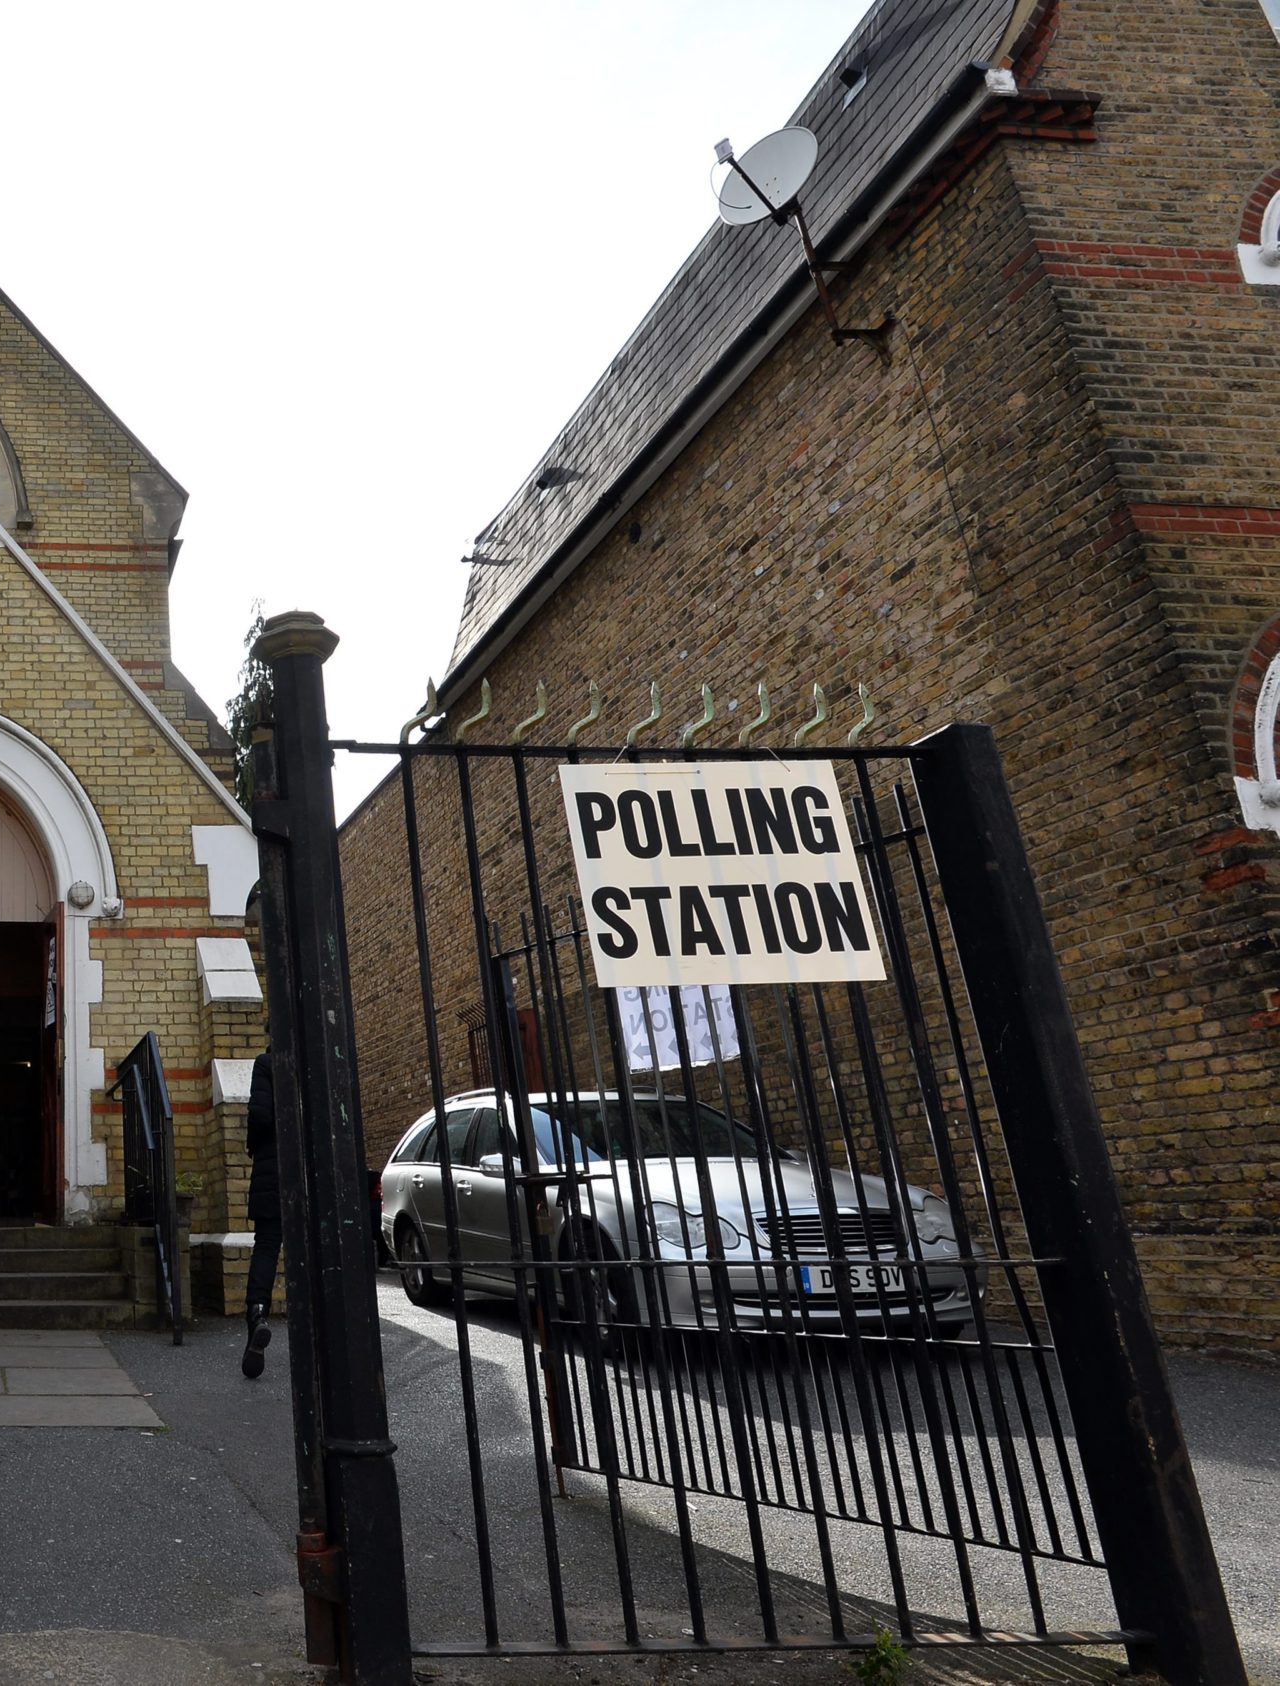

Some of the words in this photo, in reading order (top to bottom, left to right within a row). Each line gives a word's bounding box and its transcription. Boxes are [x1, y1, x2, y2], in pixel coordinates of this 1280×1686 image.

[575, 786, 840, 859] POLLING
[591, 882, 870, 959] STATION
[820, 1268, 861, 1289] DS
